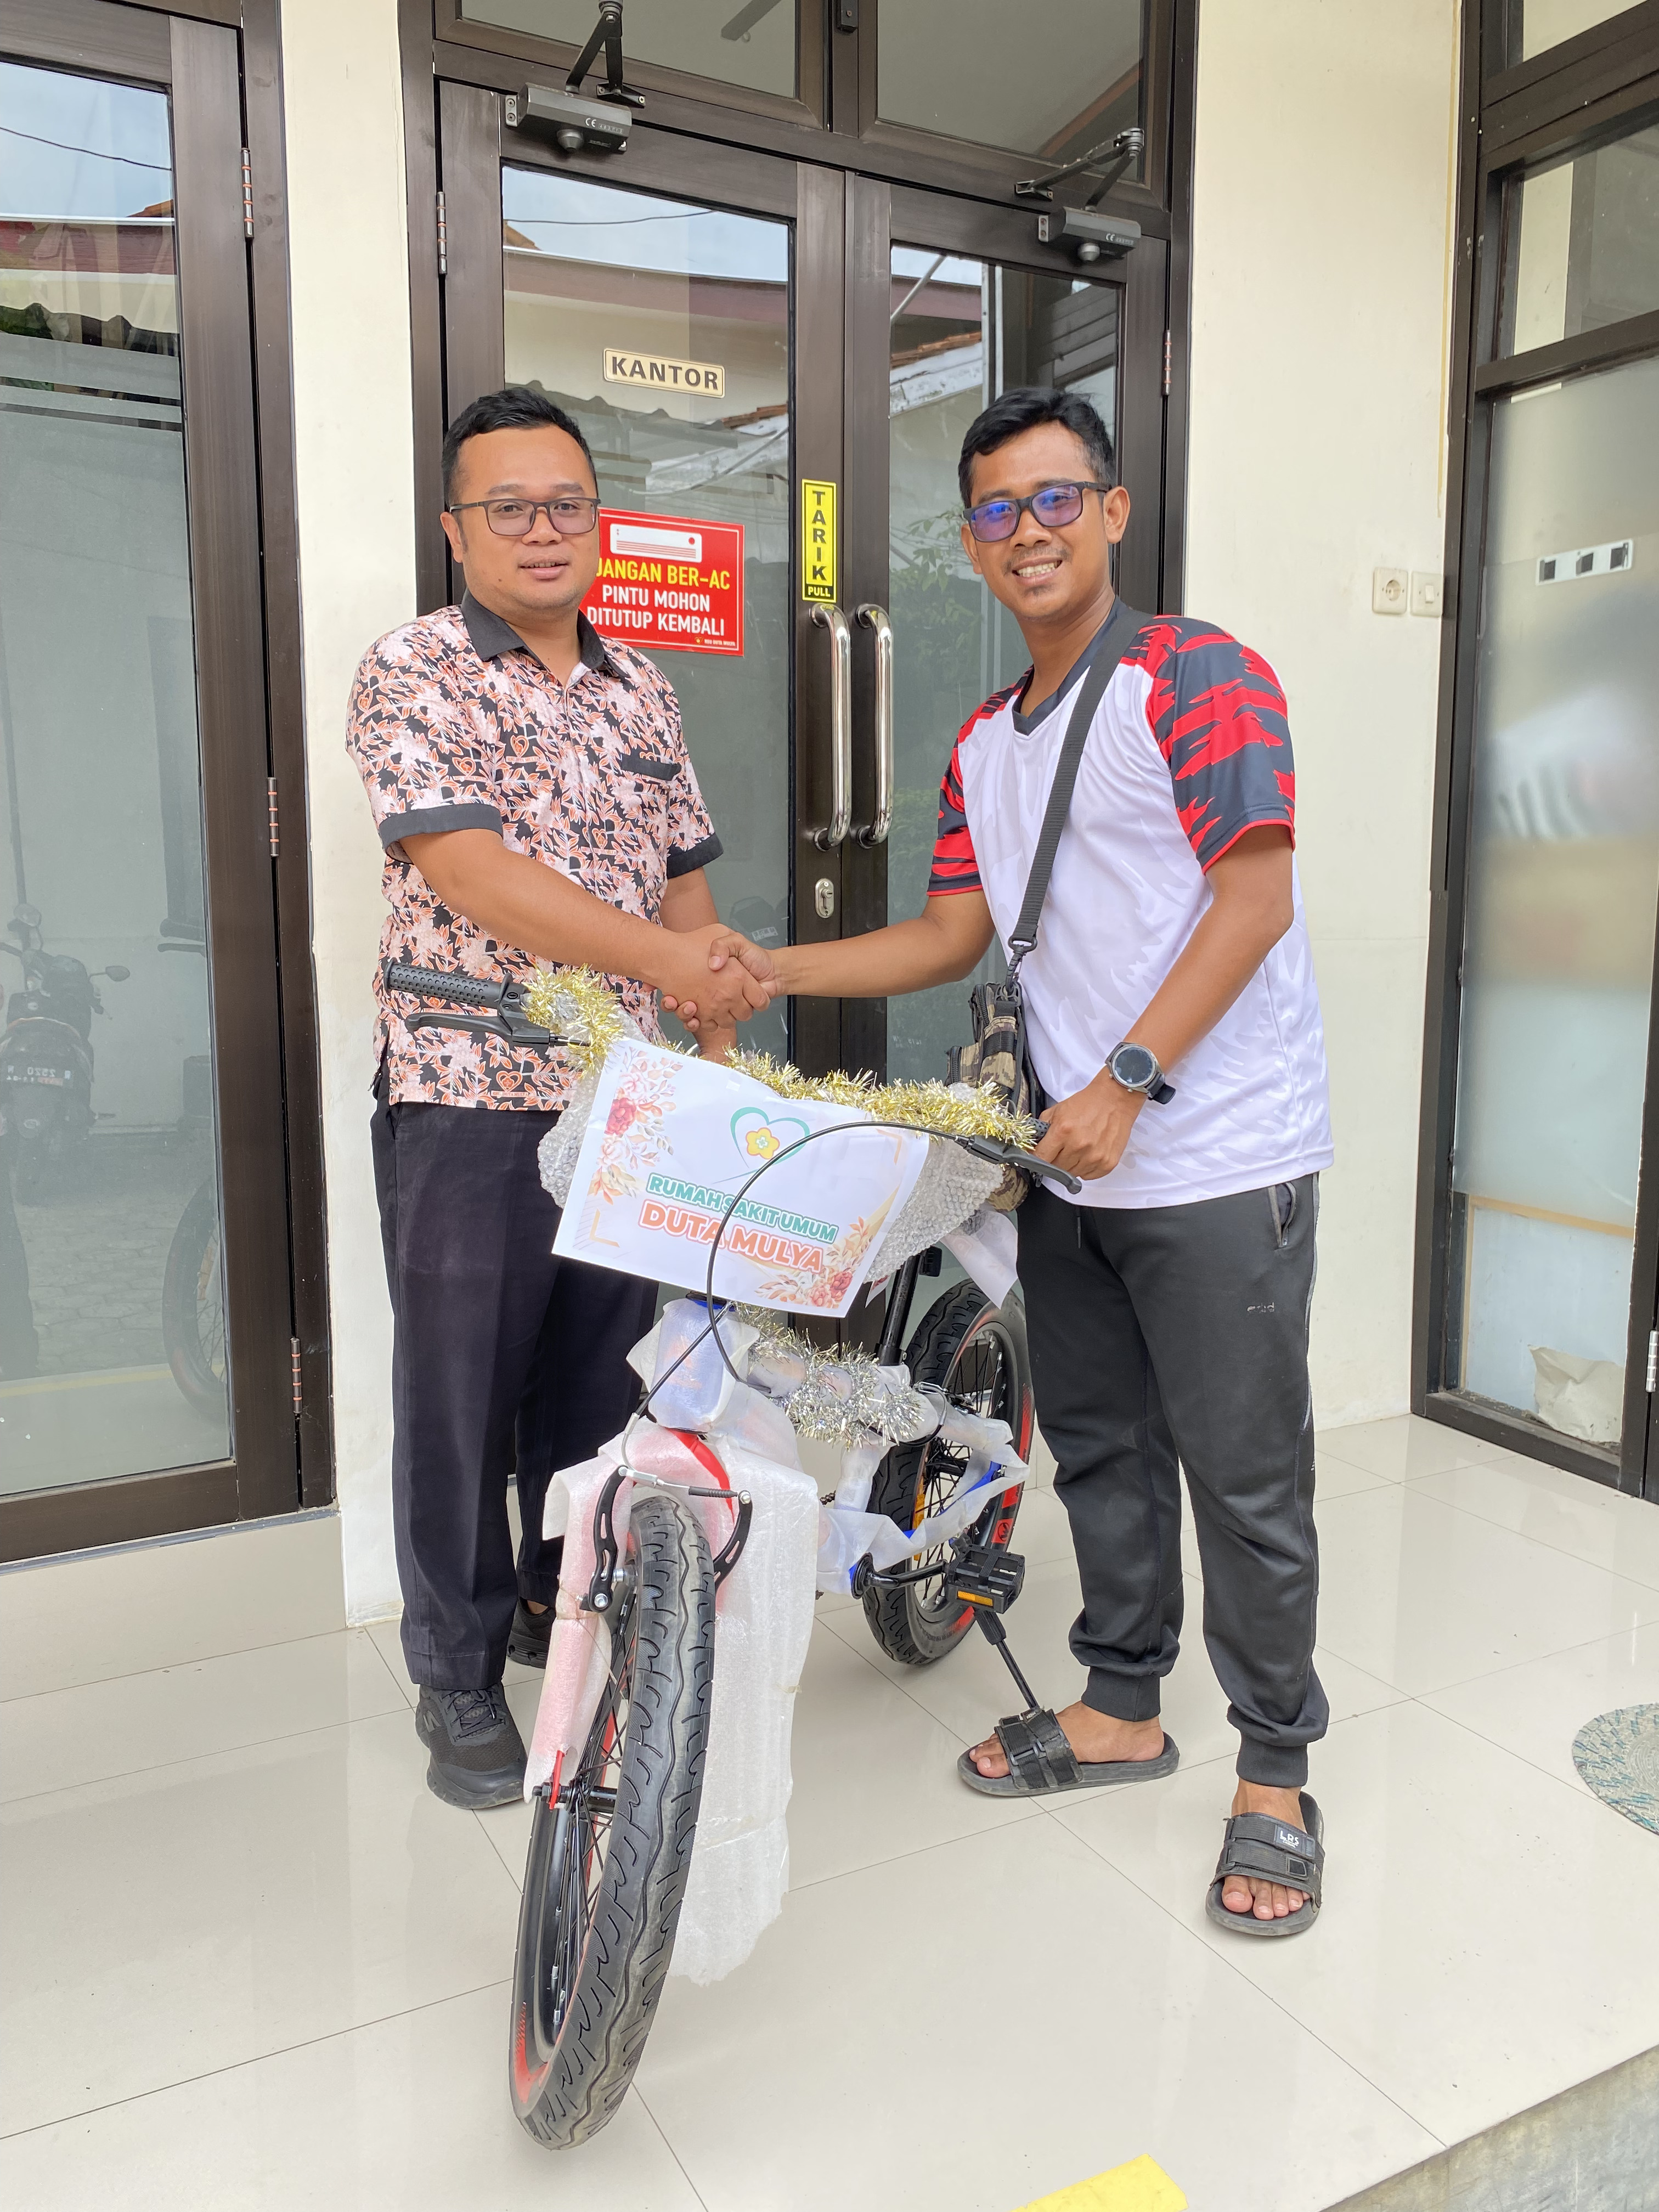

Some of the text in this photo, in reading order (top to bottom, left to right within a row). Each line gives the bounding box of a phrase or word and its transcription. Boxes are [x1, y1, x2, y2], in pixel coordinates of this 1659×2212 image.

[612, 356, 718, 390] KANTOR
[812, 490, 827, 581] TARIK
[667, 565, 730, 590] BER-AC
[808, 586, 831, 597] PULL
[602, 584, 710, 613] PINTU MOHON
[587, 606, 724, 636] DITUTUP KEMBALI
[647, 1173, 724, 1211] RUMAH
[780, 1211, 838, 1243] UMUM
[640, 1201, 822, 1272] DUTA MULYA
[1280, 1830, 1299, 1845] LRS
